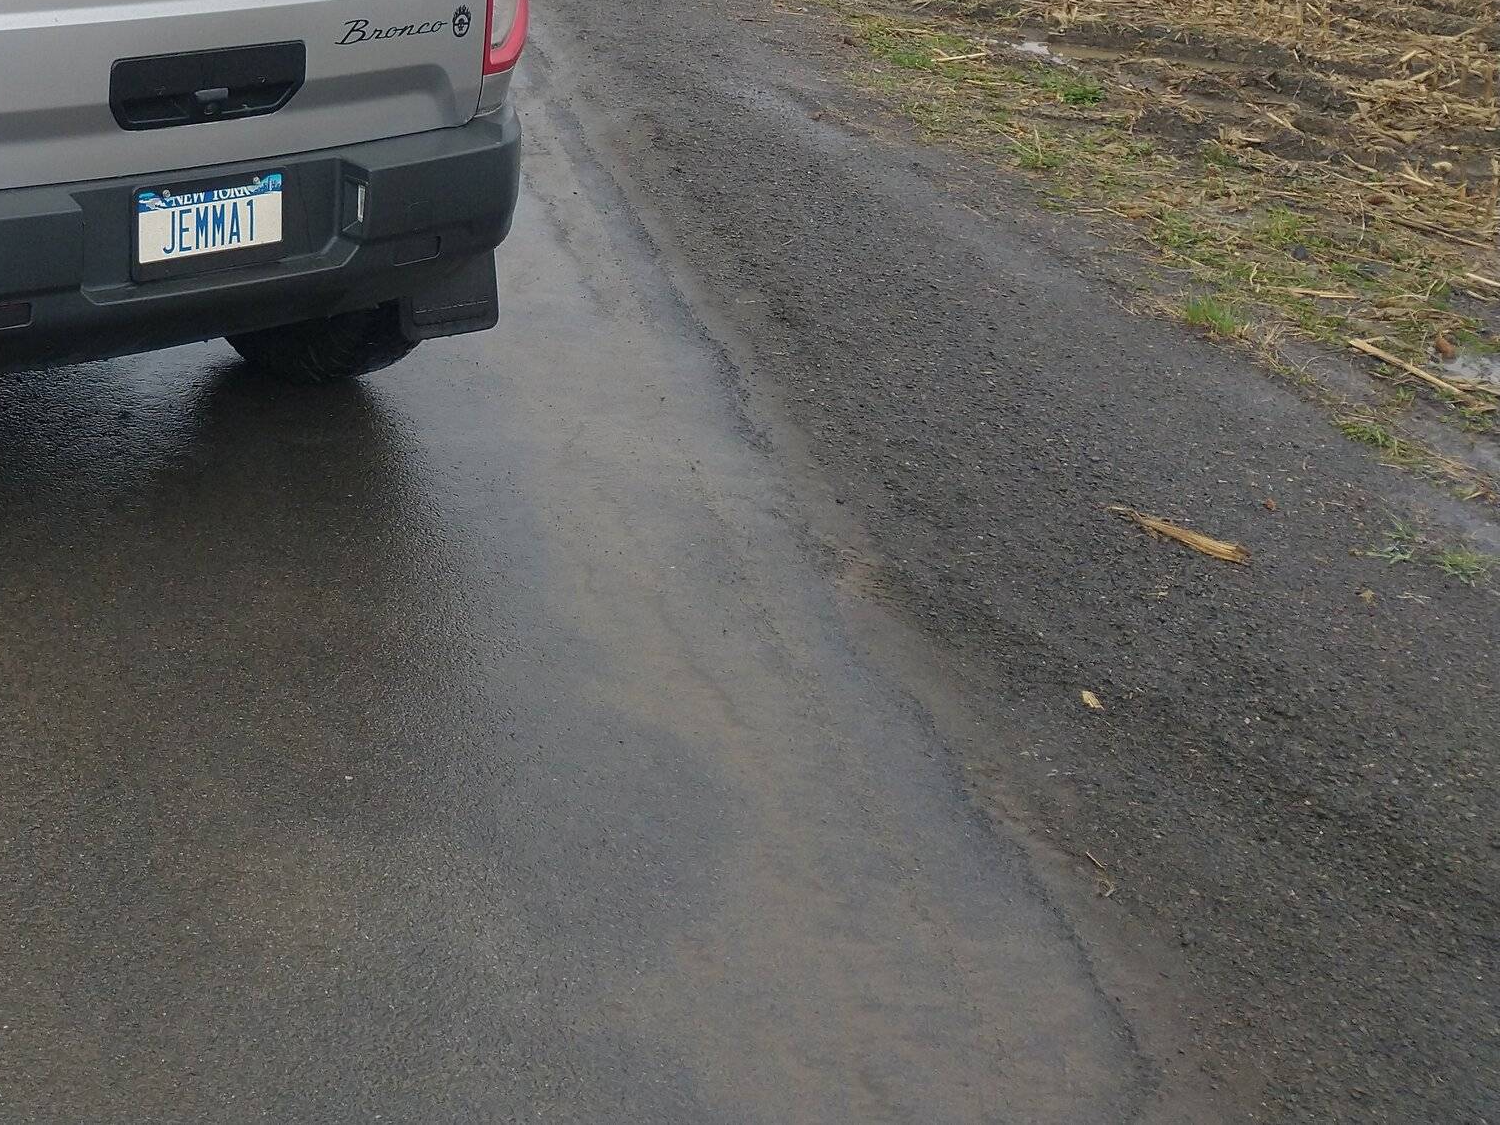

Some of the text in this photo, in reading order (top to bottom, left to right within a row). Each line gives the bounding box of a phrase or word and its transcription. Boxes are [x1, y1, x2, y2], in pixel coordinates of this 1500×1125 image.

[334, 19, 448, 45] Bronco
[172, 192, 205, 206] NEW
[162, 198, 255, 255] JEMMA1
